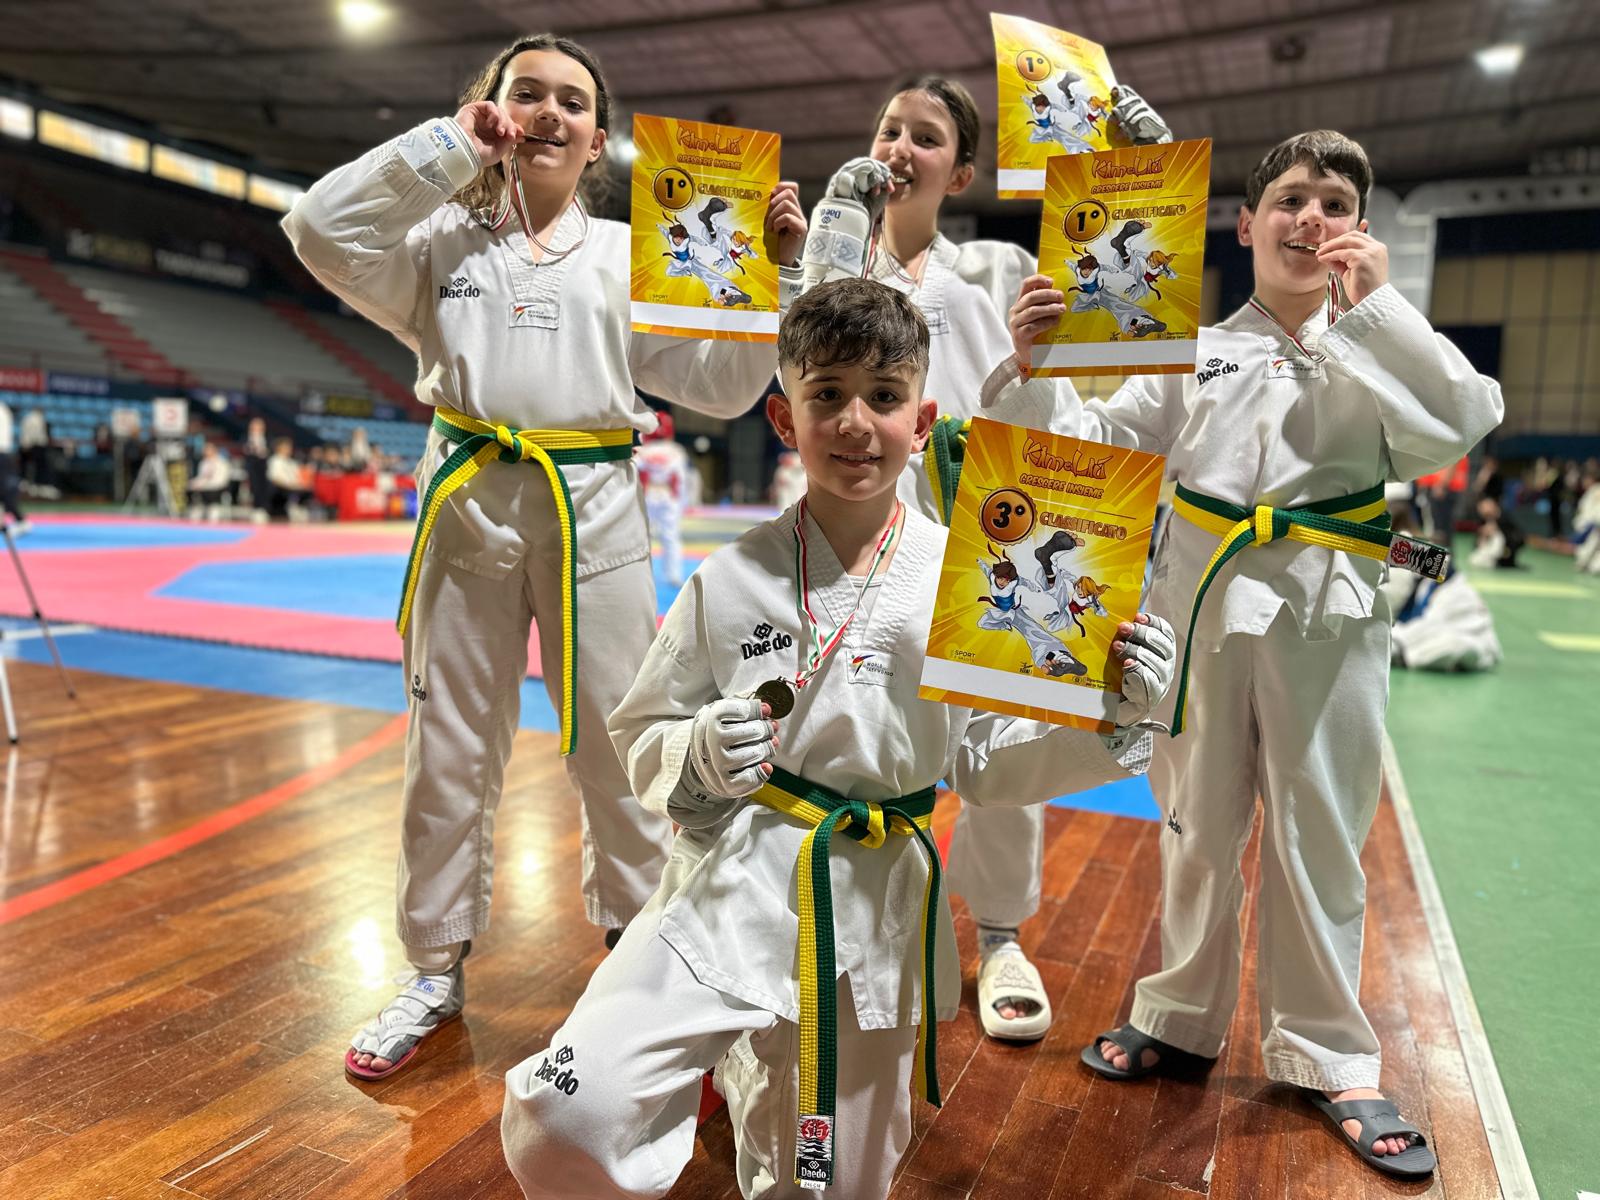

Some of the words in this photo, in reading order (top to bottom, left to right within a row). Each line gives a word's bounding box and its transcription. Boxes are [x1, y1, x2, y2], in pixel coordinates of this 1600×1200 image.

[697, 183, 762, 201] CLASSIFICATO
[1131, 180, 1164, 191] INSIEME
[1111, 204, 1187, 220] CLASSIFICATO
[439, 284, 480, 299] Daedo
[1196, 362, 1239, 386] Daedo
[1019, 473, 1066, 492] CRESCERE
[1065, 482, 1104, 500] INSIEME
[1040, 511, 1128, 541] CLASSIFICATO
[1428, 553, 1443, 575] Daedo
[741, 633, 792, 660] Daedo
[955, 649, 976, 657] SPORT
[801, 1167, 827, 1179] Daedo
